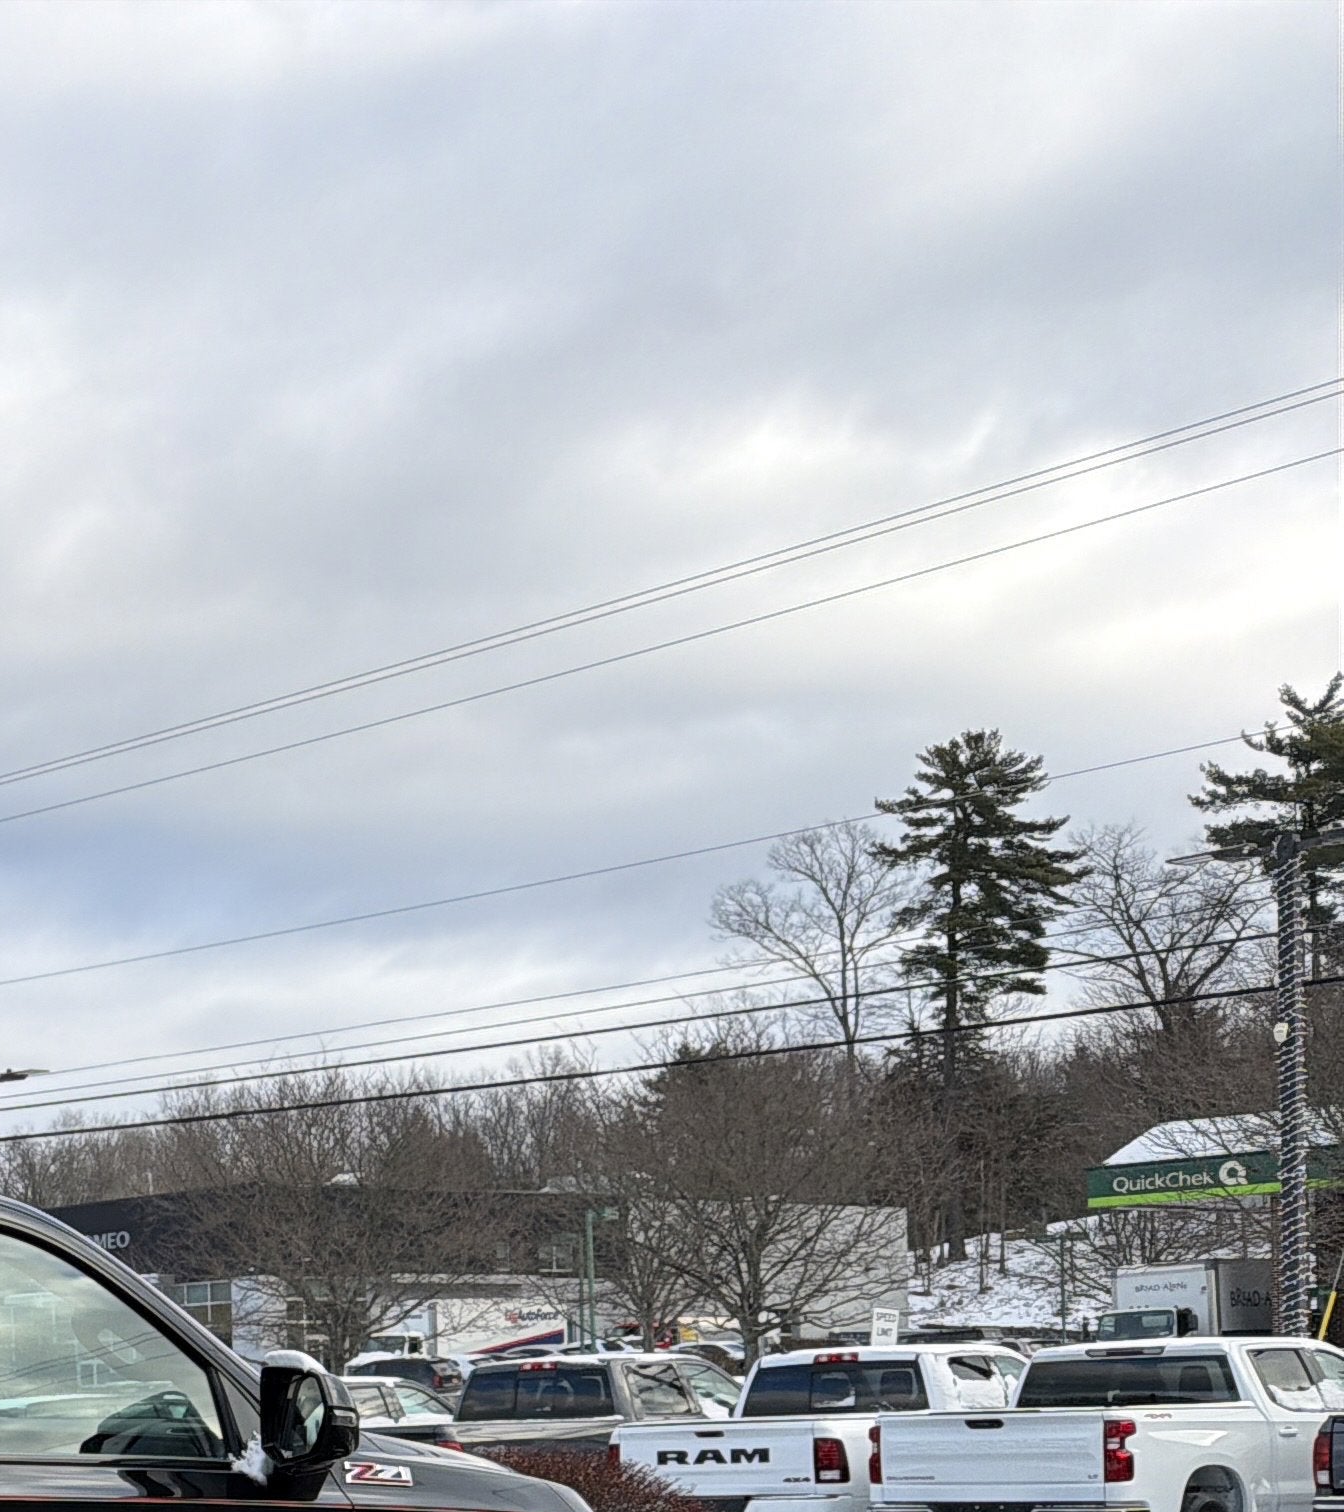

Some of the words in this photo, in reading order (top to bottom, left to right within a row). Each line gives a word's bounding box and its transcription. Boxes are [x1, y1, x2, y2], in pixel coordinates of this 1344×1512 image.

[1112, 1170, 1214, 1194] QuickChek
[86, 1230, 131, 1250] MEO
[657, 1447, 770, 1465] RAM
[344, 1461, 413, 1487] Z71
